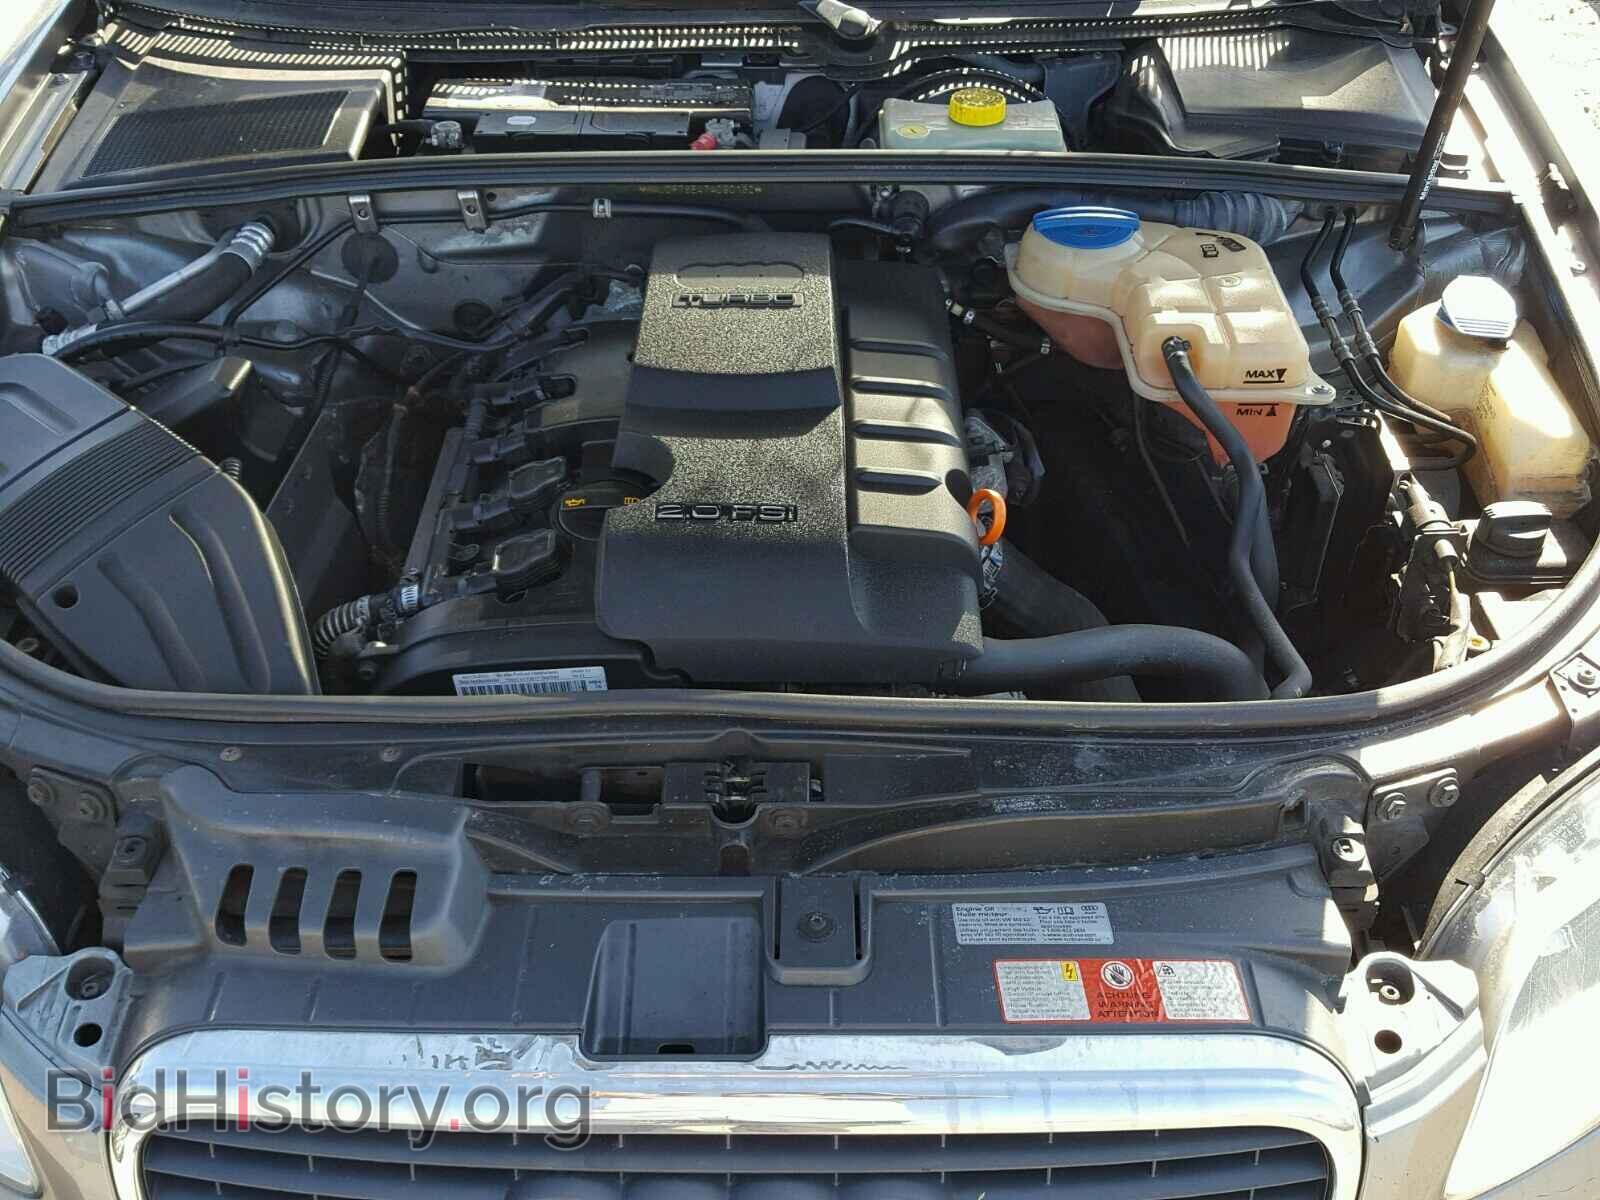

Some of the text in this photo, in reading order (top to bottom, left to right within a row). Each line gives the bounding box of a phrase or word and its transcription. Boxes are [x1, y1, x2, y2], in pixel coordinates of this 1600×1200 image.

[1245, 369, 1275, 379] MAX
[1236, 408, 1263, 416] MIN
[656, 503, 721, 520] 2.0
